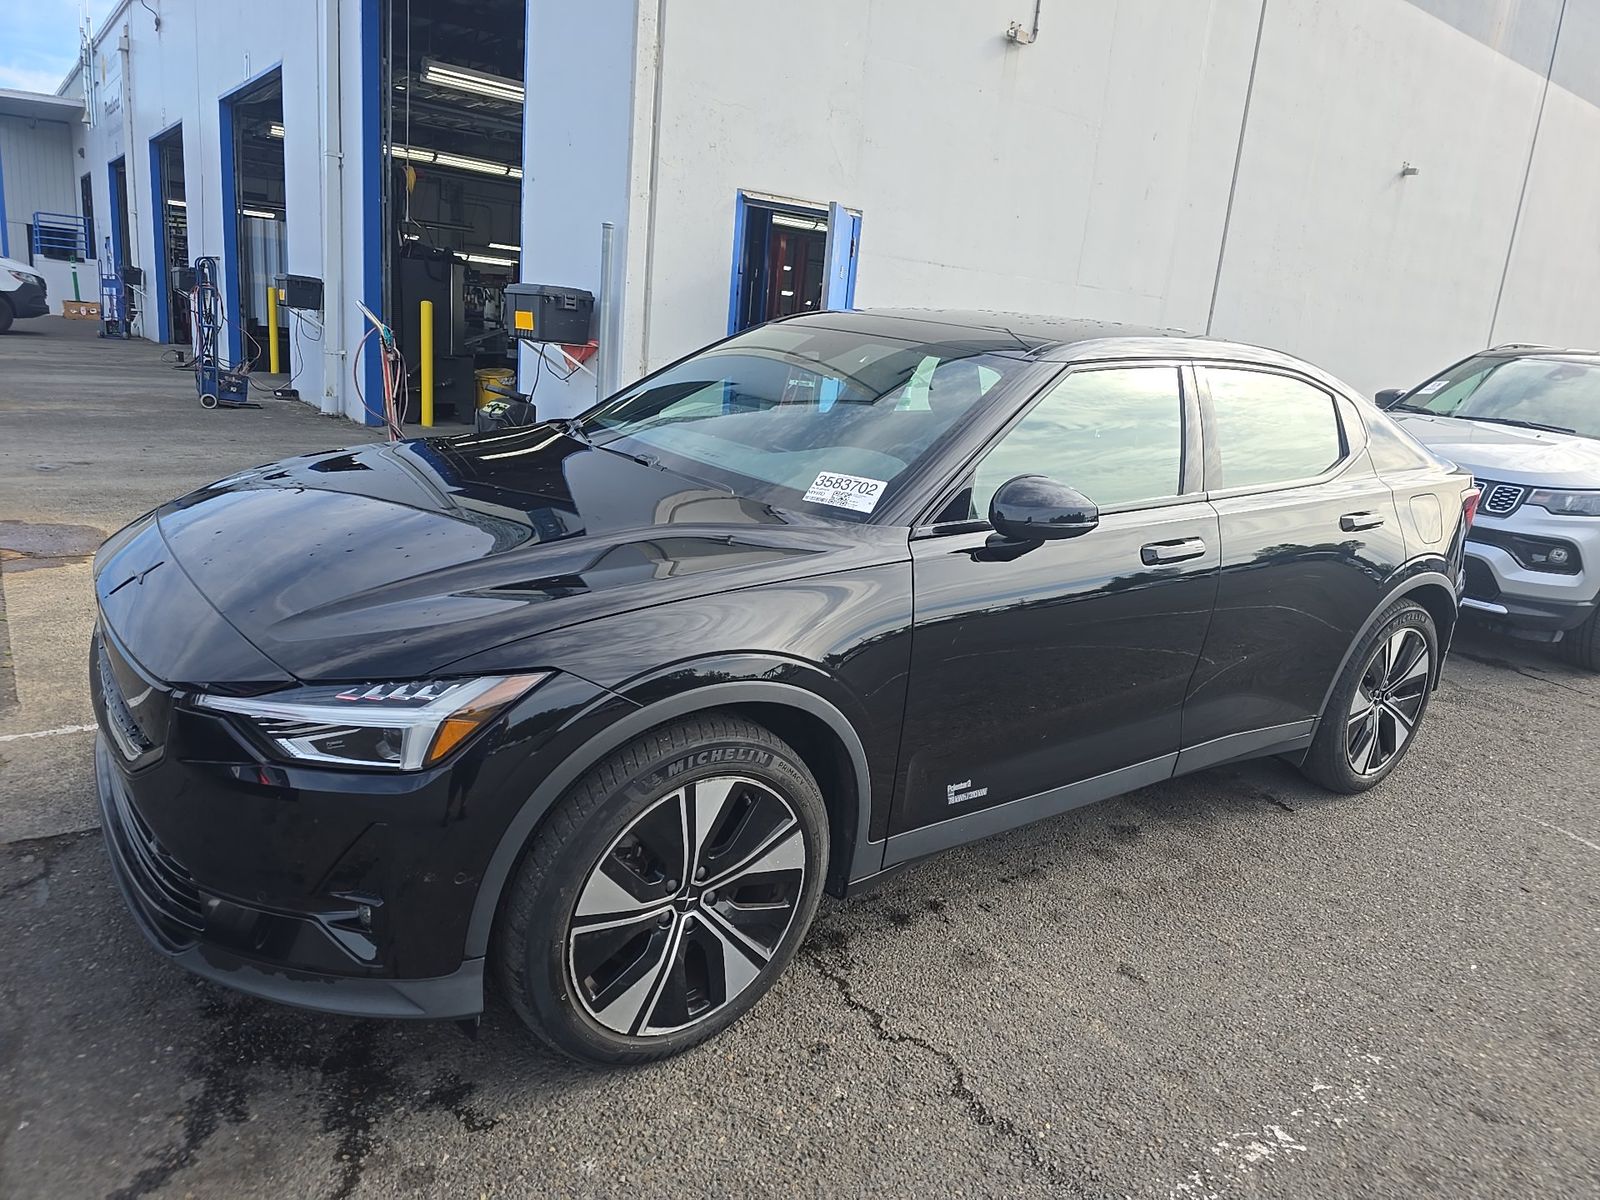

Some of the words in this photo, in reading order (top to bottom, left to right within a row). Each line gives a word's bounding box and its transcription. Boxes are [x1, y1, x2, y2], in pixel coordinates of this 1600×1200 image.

[815, 475, 879, 497] 3583702
[667, 748, 769, 777] MICHELIN
[778, 761, 805, 786] PRIMACY
